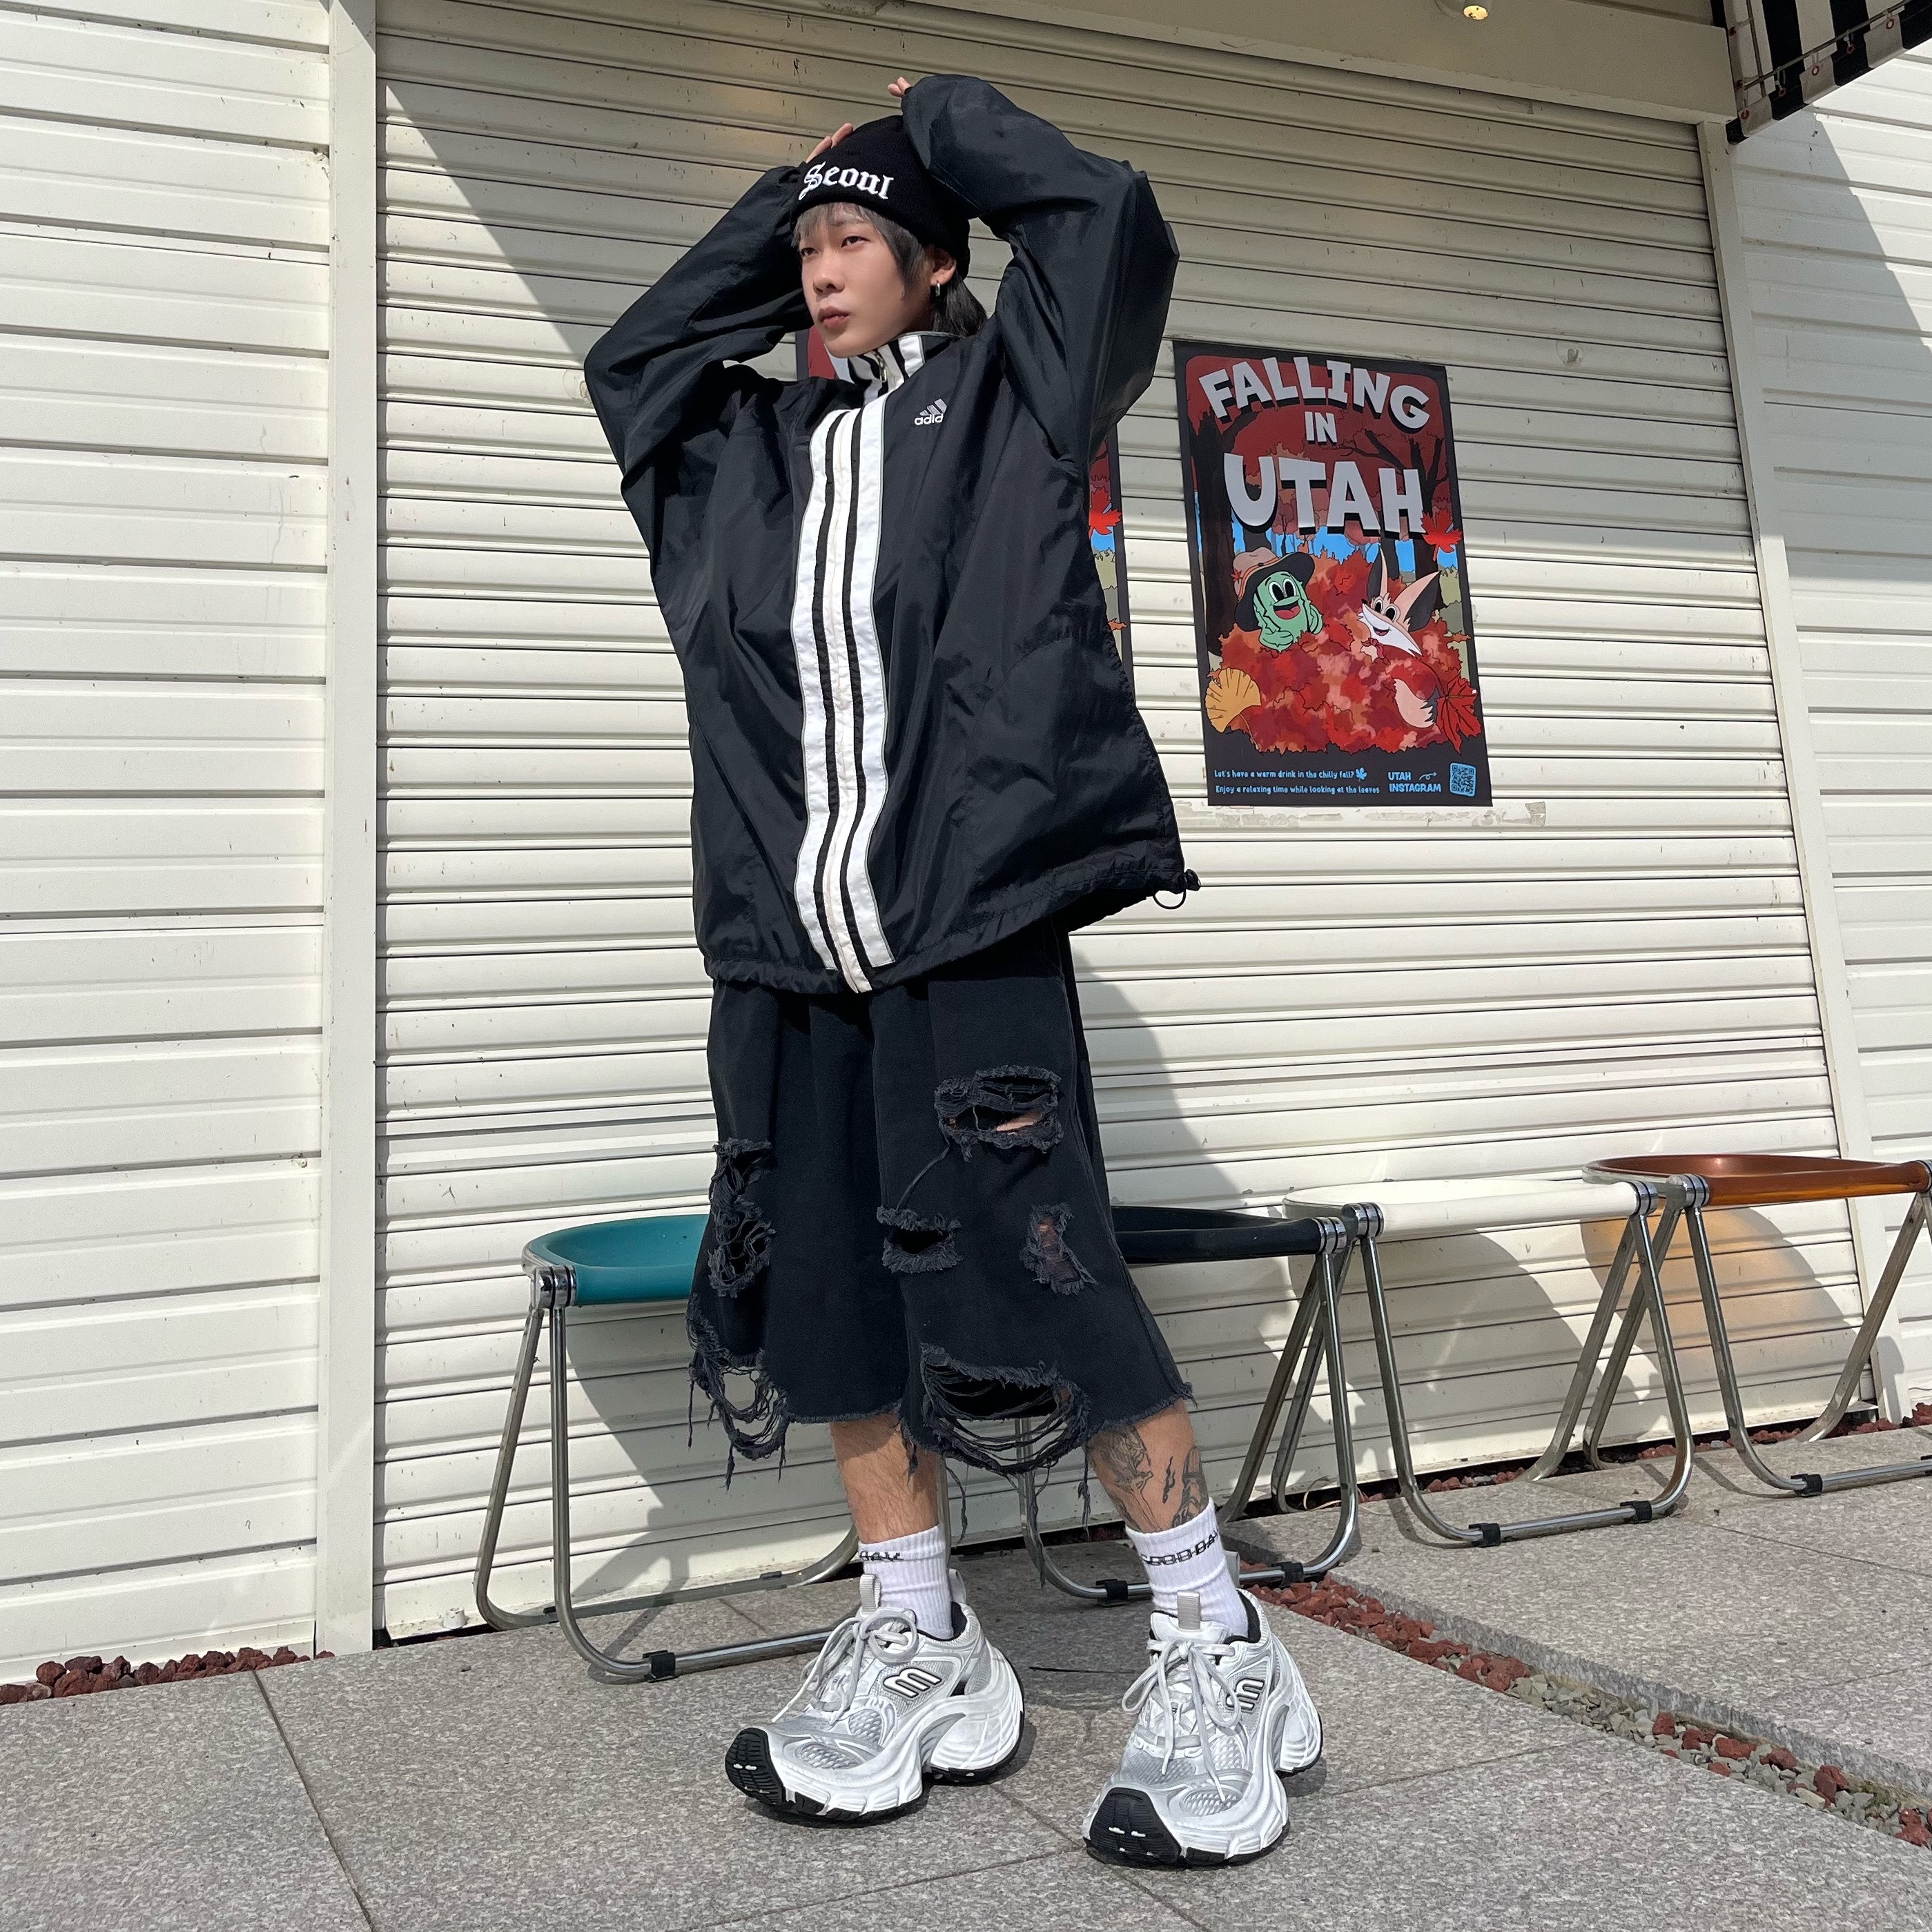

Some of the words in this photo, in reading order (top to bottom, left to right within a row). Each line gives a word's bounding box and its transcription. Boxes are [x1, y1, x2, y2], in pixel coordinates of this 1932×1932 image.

[799, 161, 894, 199] Seoul
[1198, 356, 1430, 430] FALLING
[914, 413, 944, 426] adid
[1304, 411, 1338, 443] IN
[1224, 453, 1425, 534] UTAH
[1214, 770, 1231, 778] Let's
[1231, 770, 1249, 778] have
[1278, 770, 1296, 778] drink
[1339, 770, 1355, 779] fall?
[1387, 771, 1412, 781] UTAH
[1216, 786, 1234, 794] Enjoy
[1242, 786, 1271, 794] relaxing
[1289, 786, 1308, 794] while
[1309, 786, 1336, 794] looking
[1358, 786, 1380, 794] leaves
[1389, 783, 1442, 793] INSTAGRAM
